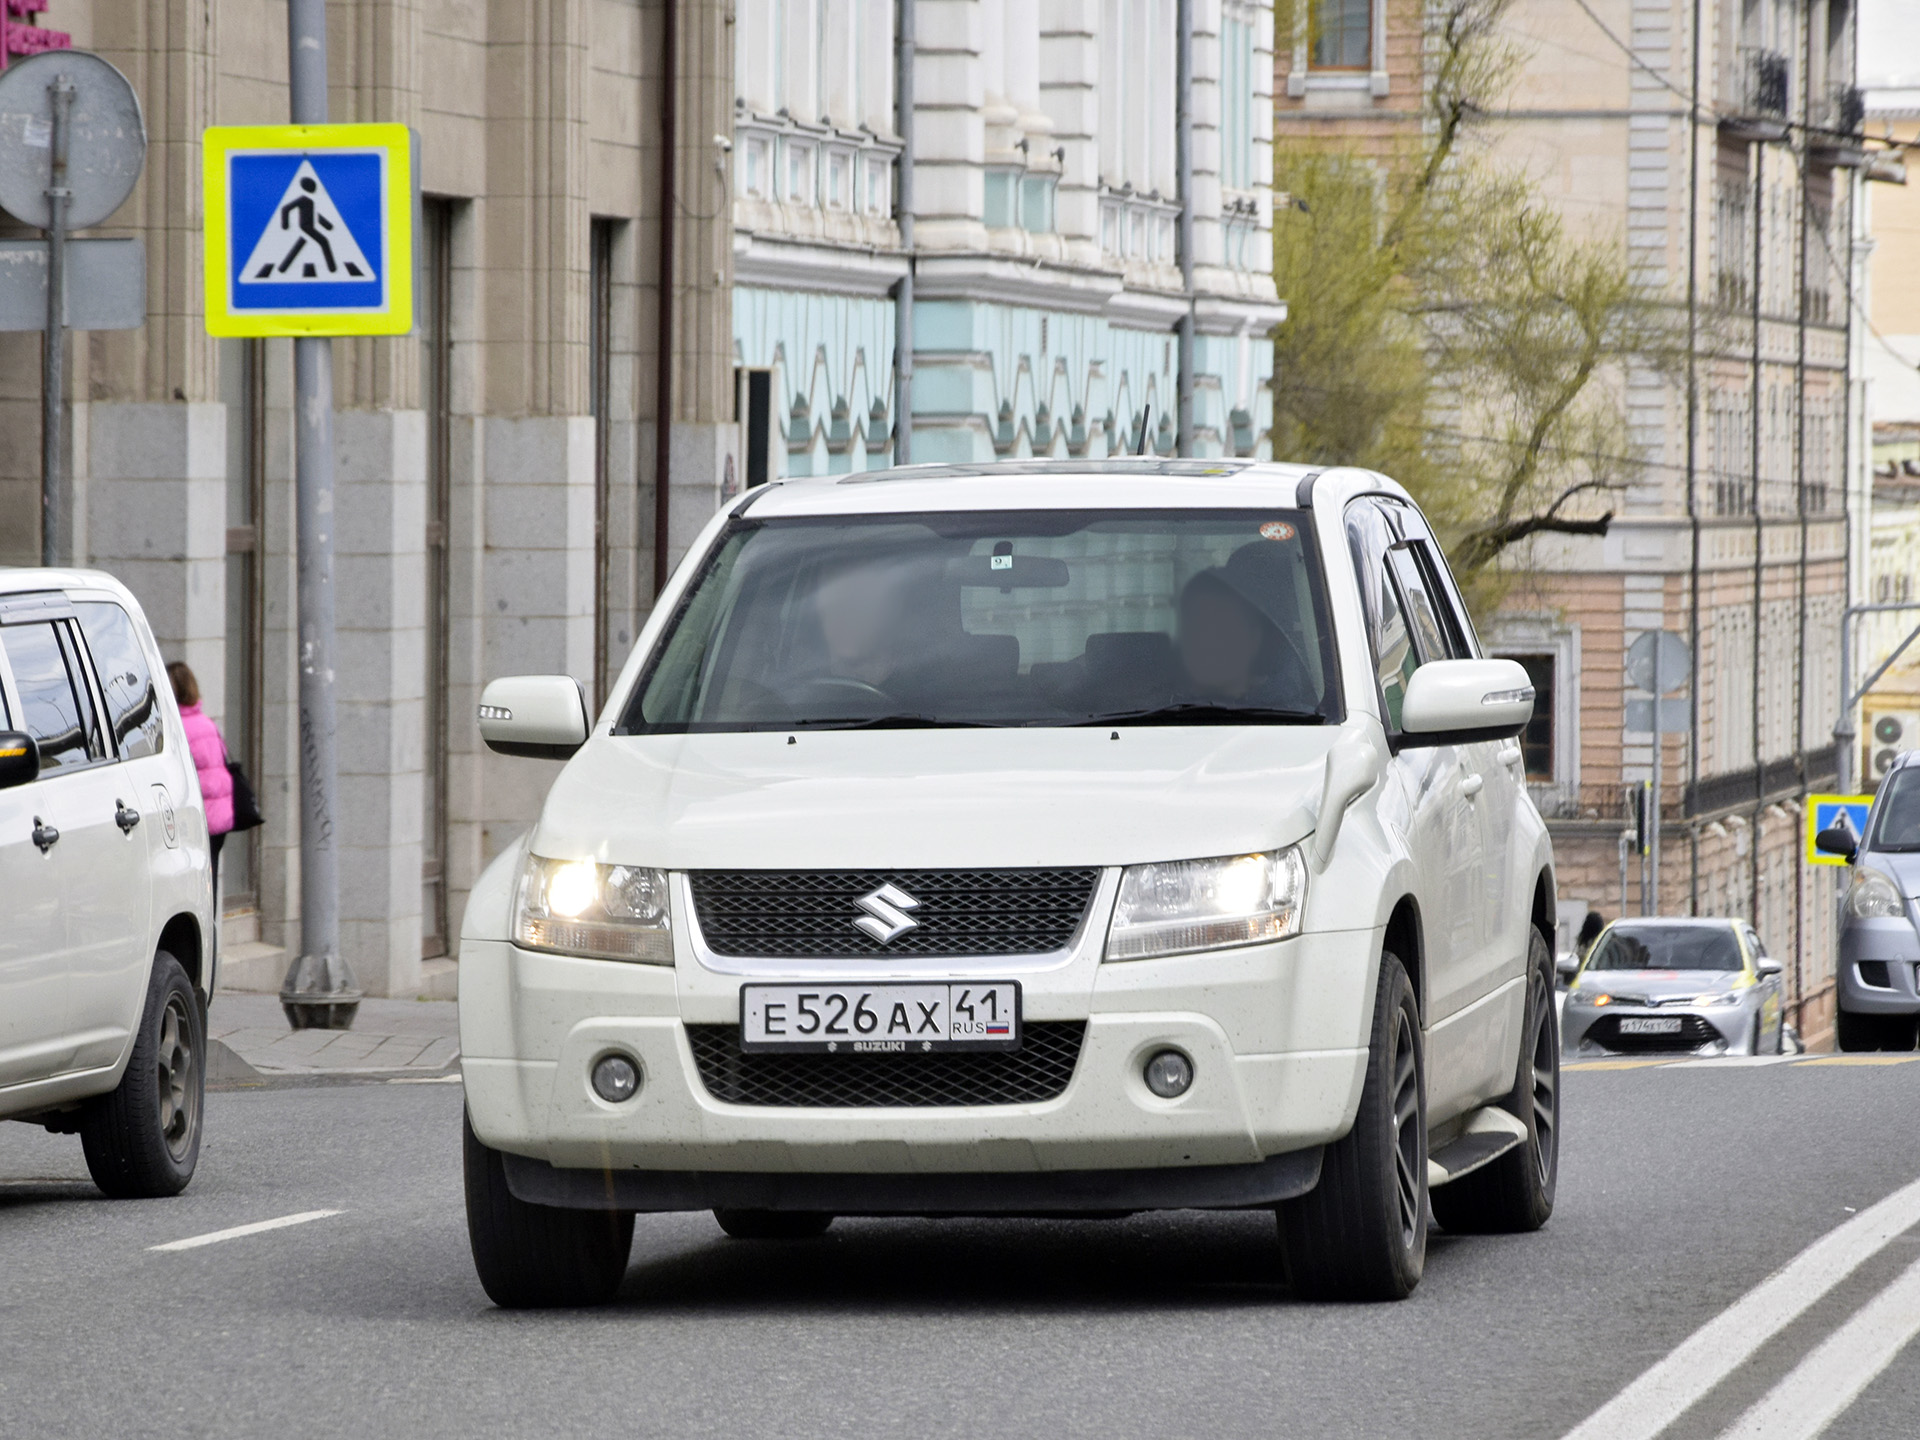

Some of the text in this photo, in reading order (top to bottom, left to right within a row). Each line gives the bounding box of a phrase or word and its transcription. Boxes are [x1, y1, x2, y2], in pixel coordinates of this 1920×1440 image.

[764, 989, 998, 1034] Е526АХ 41
[953, 1022, 984, 1034] RUS
[853, 1041, 906, 1052] SUZUKI
